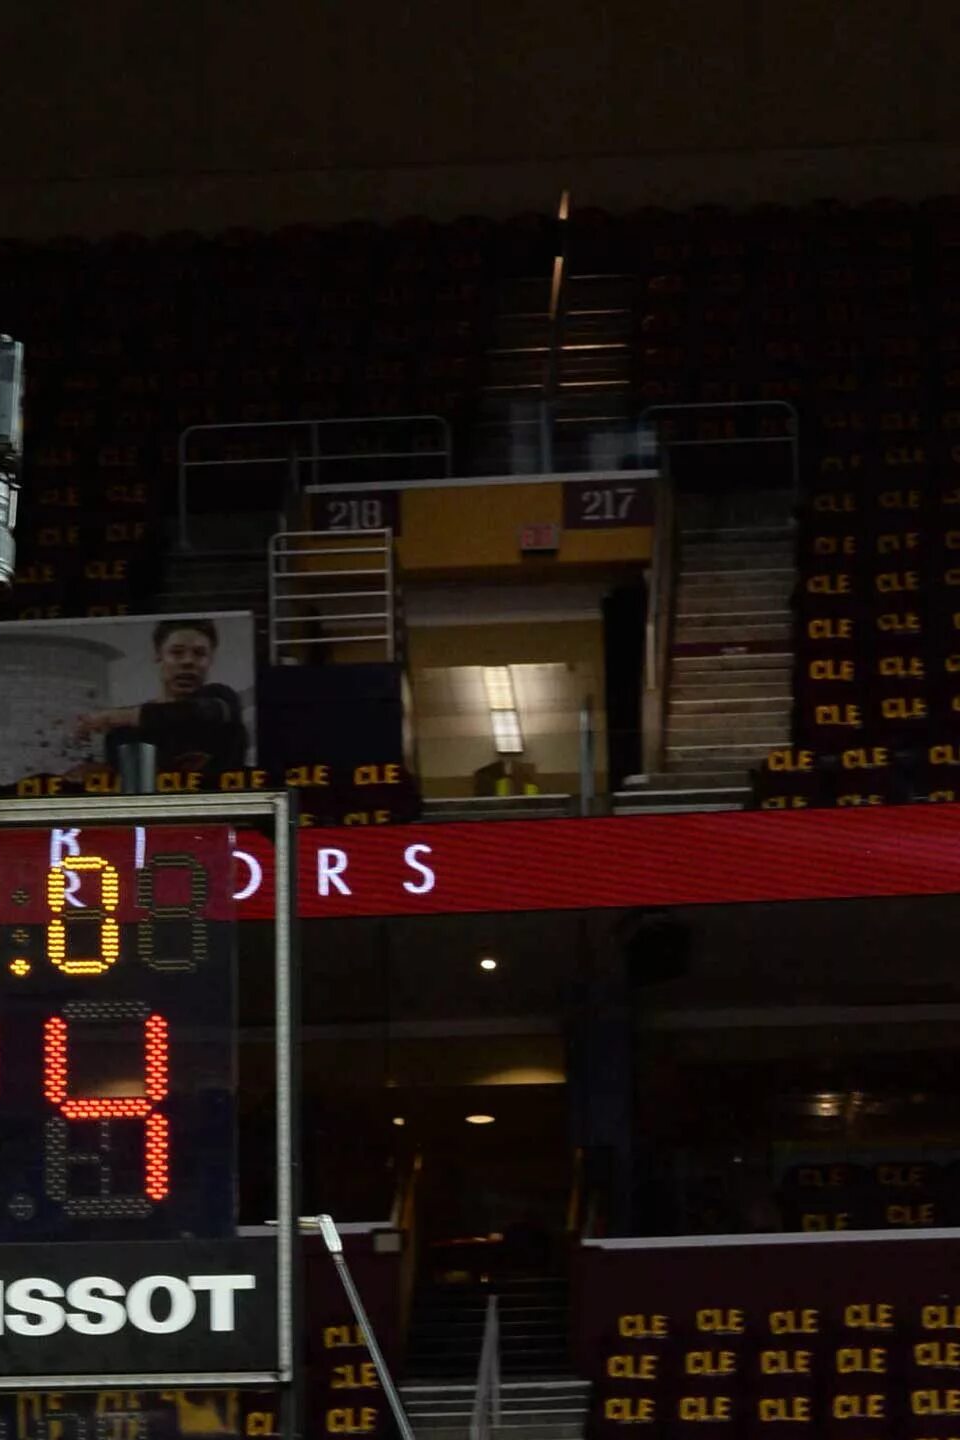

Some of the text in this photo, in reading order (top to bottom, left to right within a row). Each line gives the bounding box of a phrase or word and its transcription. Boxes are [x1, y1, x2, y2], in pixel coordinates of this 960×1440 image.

[327, 499, 384, 530] 218
[581, 488, 636, 520] 217
[808, 618, 853, 639] CLE
[809, 658, 855, 681] CLE
[879, 656, 925, 679] CLE
[815, 704, 862, 728] CLE
[882, 697, 929, 720] CLE
[768, 749, 815, 772] CLE
[842, 747, 889, 770] CLE
[355, 763, 401, 785] CLE
[618, 1315, 666, 1336] CLE
[696, 1309, 744, 1331] CLE
[769, 1309, 816, 1334] CLE
[844, 1304, 891, 1328] CLE
[607, 1355, 655, 1379] CLE
[685, 1351, 733, 1374] CLE
[760, 1351, 809, 1374] CLE
[836, 1348, 886, 1373] CLE
[605, 1398, 654, 1421] CLE
[679, 1397, 730, 1420] CLE
[758, 1397, 809, 1421] CLE
[833, 1395, 885, 1419] CLE
[326, 1408, 375, 1432] CLE
